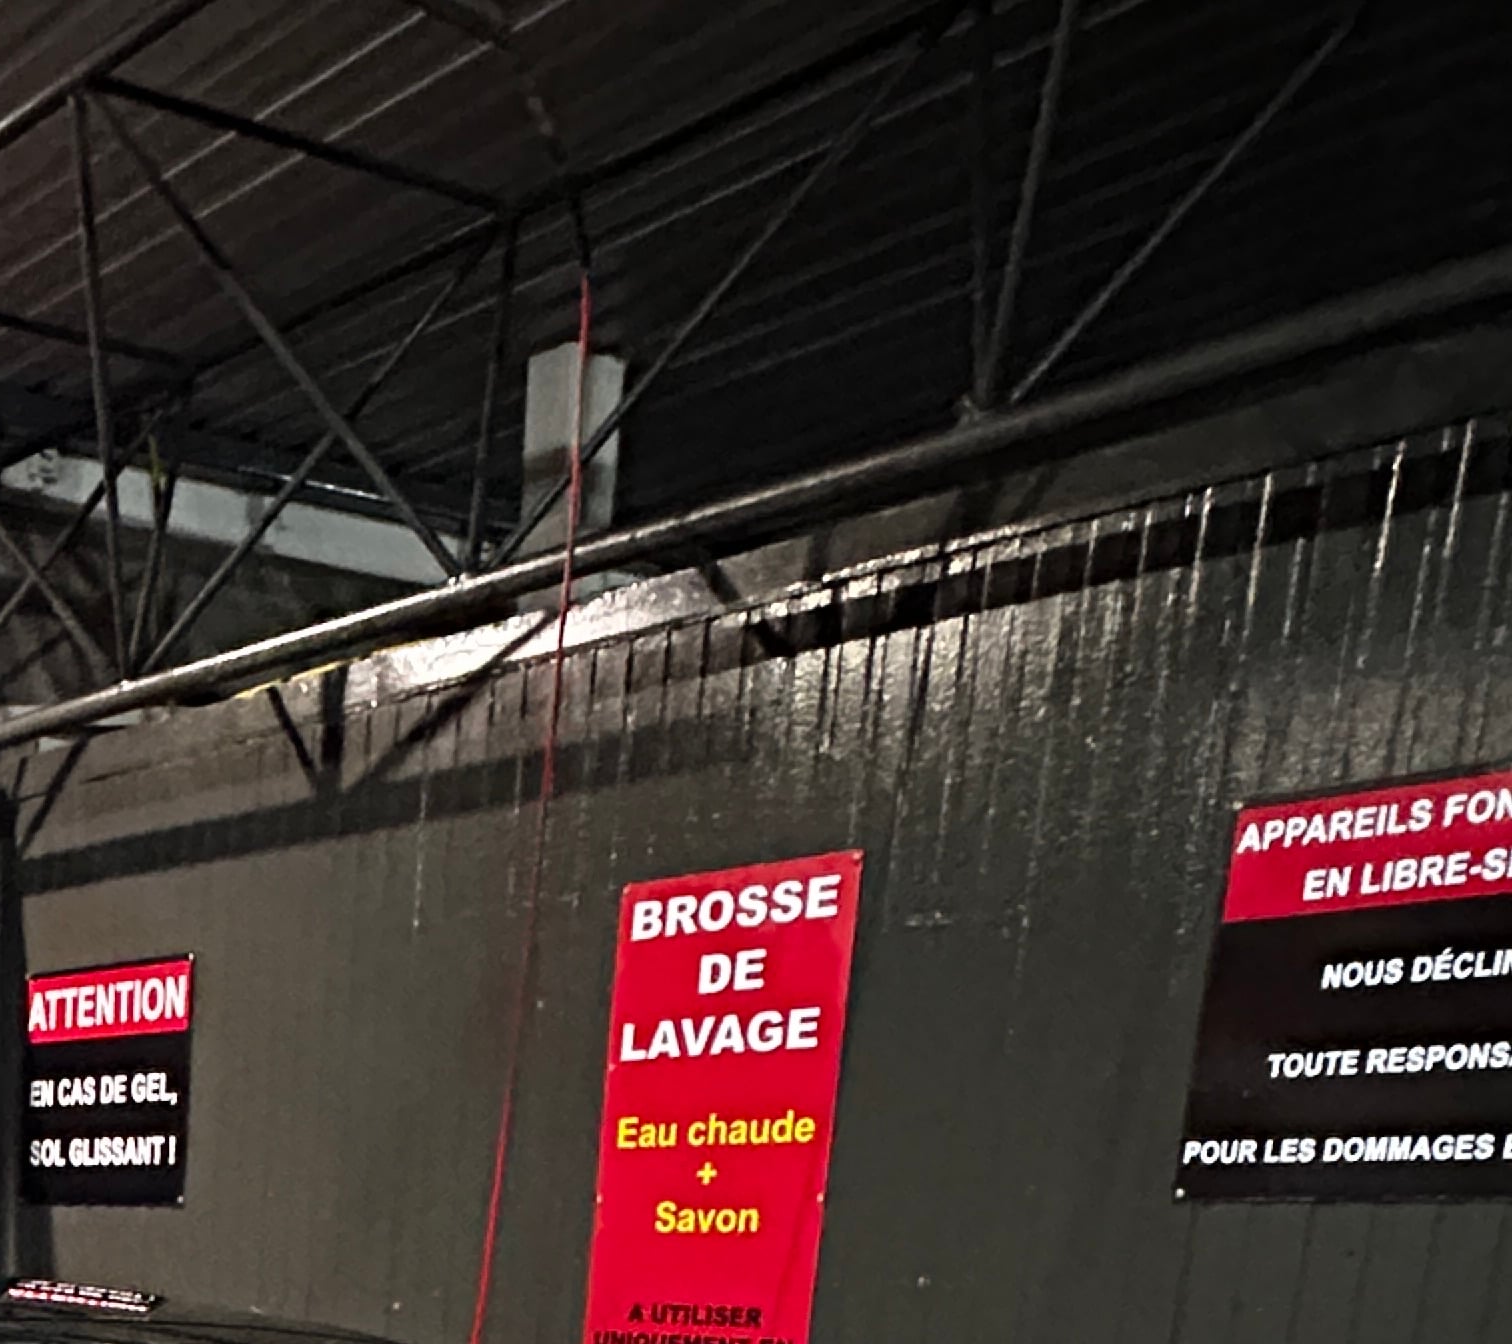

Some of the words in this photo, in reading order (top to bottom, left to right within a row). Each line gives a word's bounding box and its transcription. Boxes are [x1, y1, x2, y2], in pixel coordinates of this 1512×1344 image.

[1236, 799, 1433, 854] APPAREILS
[1302, 866, 1353, 901] EN
[1360, 847, 1512, 895] LIBRE-S
[631, 874, 841, 942] BROSSE
[698, 948, 767, 995] DE
[1320, 958, 1403, 990] NOUS
[28, 974, 188, 1033] ATTENTION
[620, 1007, 821, 1062] LAVAGE
[1268, 1049, 1360, 1078] TOUTE
[1366, 1041, 1512, 1074] RESPONS
[30, 1080, 54, 1108] EN
[57, 1076, 96, 1107] CAS
[100, 1074, 128, 1104] DE
[131, 1072, 178, 1106] GEL,
[616, 1116, 678, 1149] Eau
[688, 1109, 816, 1147] chaude
[30, 1138, 66, 1167] SOL
[68, 1135, 165, 1168] GLISSANT
[1183, 1139, 1257, 1165] POUR
[1263, 1137, 1316, 1163] LES
[1323, 1133, 1496, 1162] DOMMAGES
[654, 1201, 760, 1234] Savon
[650, 1303, 762, 1329] UTILISER
